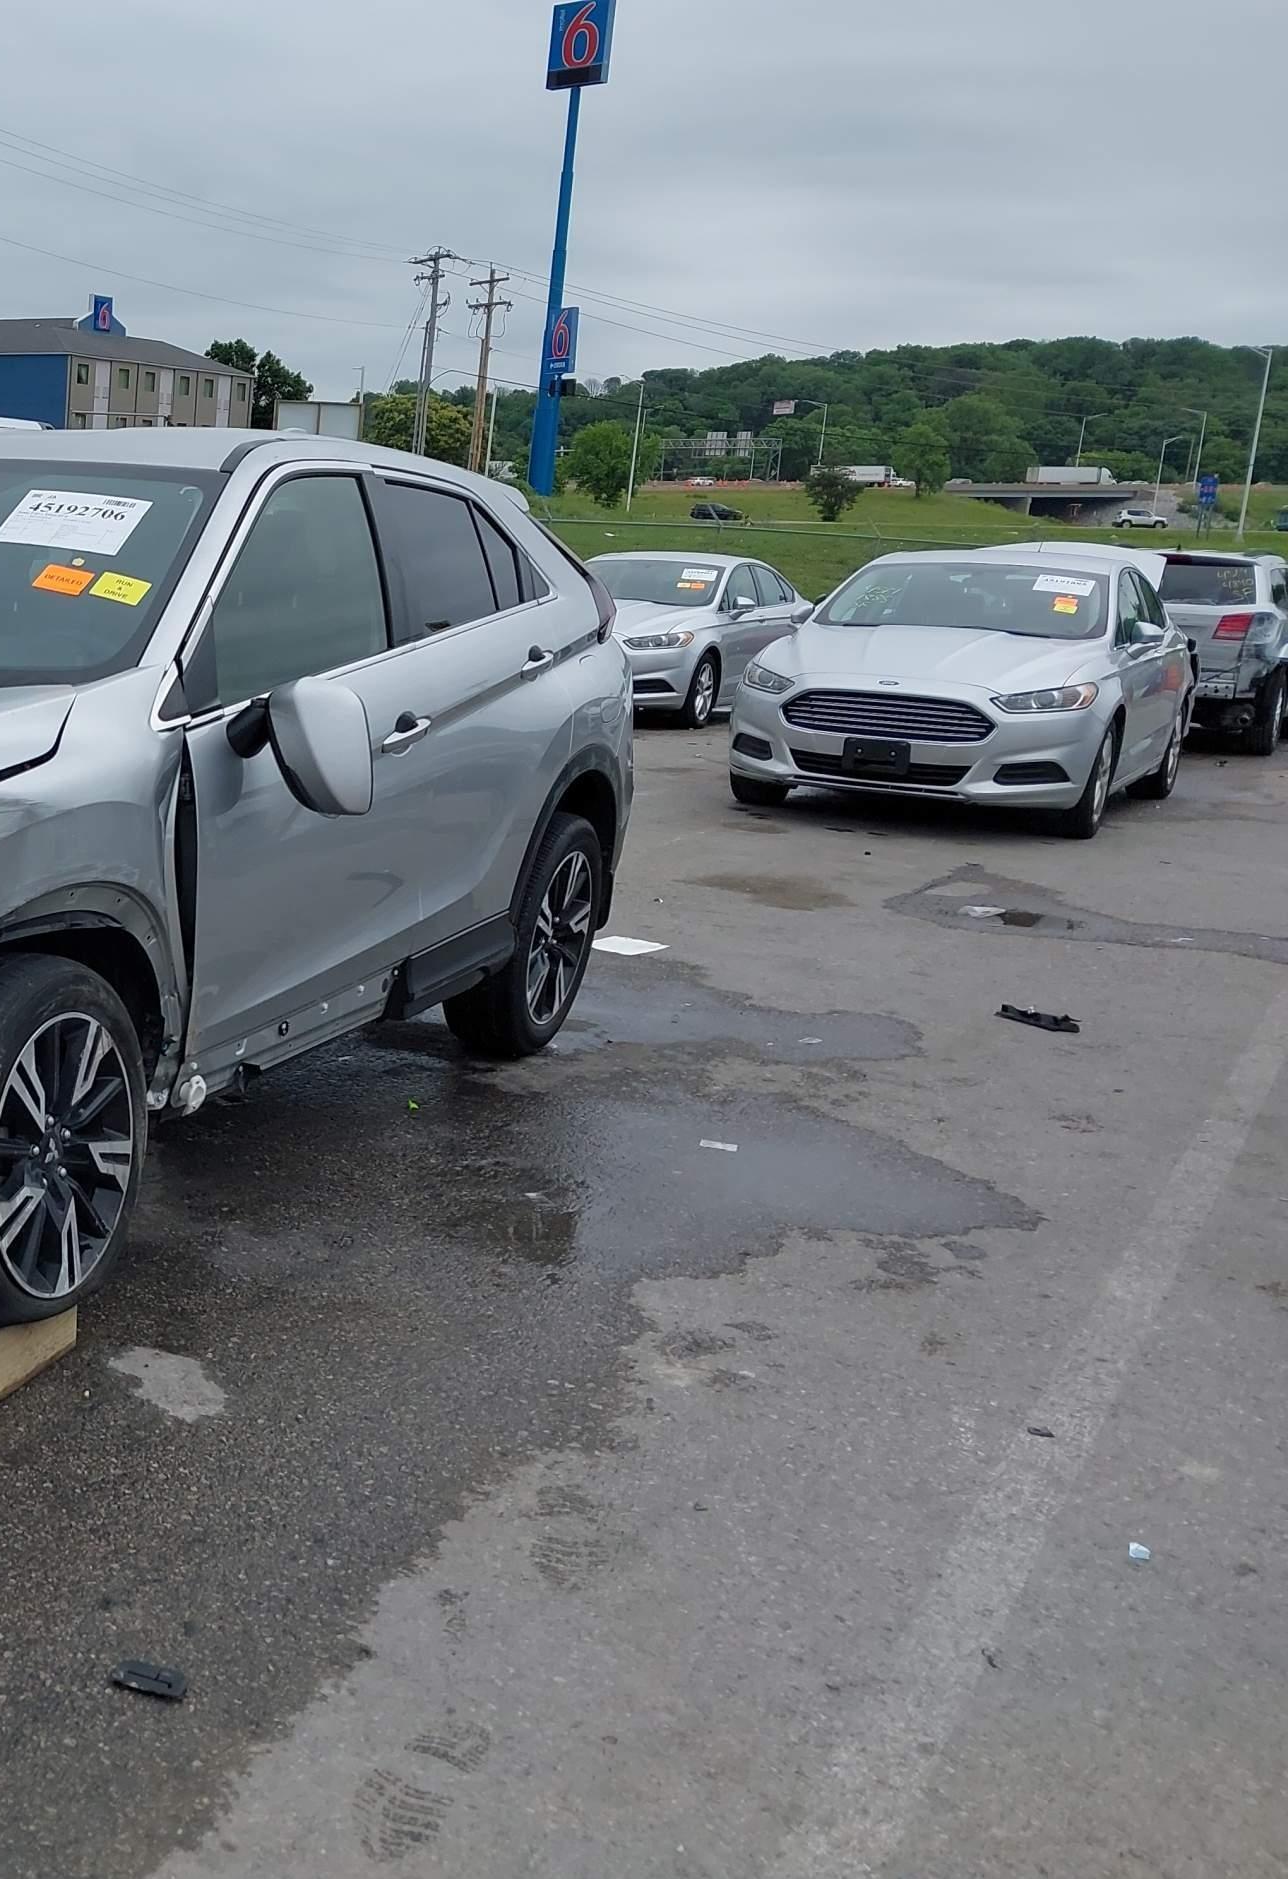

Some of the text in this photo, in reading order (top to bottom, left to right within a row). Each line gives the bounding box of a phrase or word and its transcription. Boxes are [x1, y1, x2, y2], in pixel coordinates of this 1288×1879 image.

[562, 1, 599, 68] 6
[99, 302, 110, 329] 6
[552, 310, 569, 358] 6
[29, 502, 128, 521] 45192706
[44, 574, 83, 586] DETAILED
[116, 579, 133, 587] RUN
[104, 588, 128, 599] DRIVE
